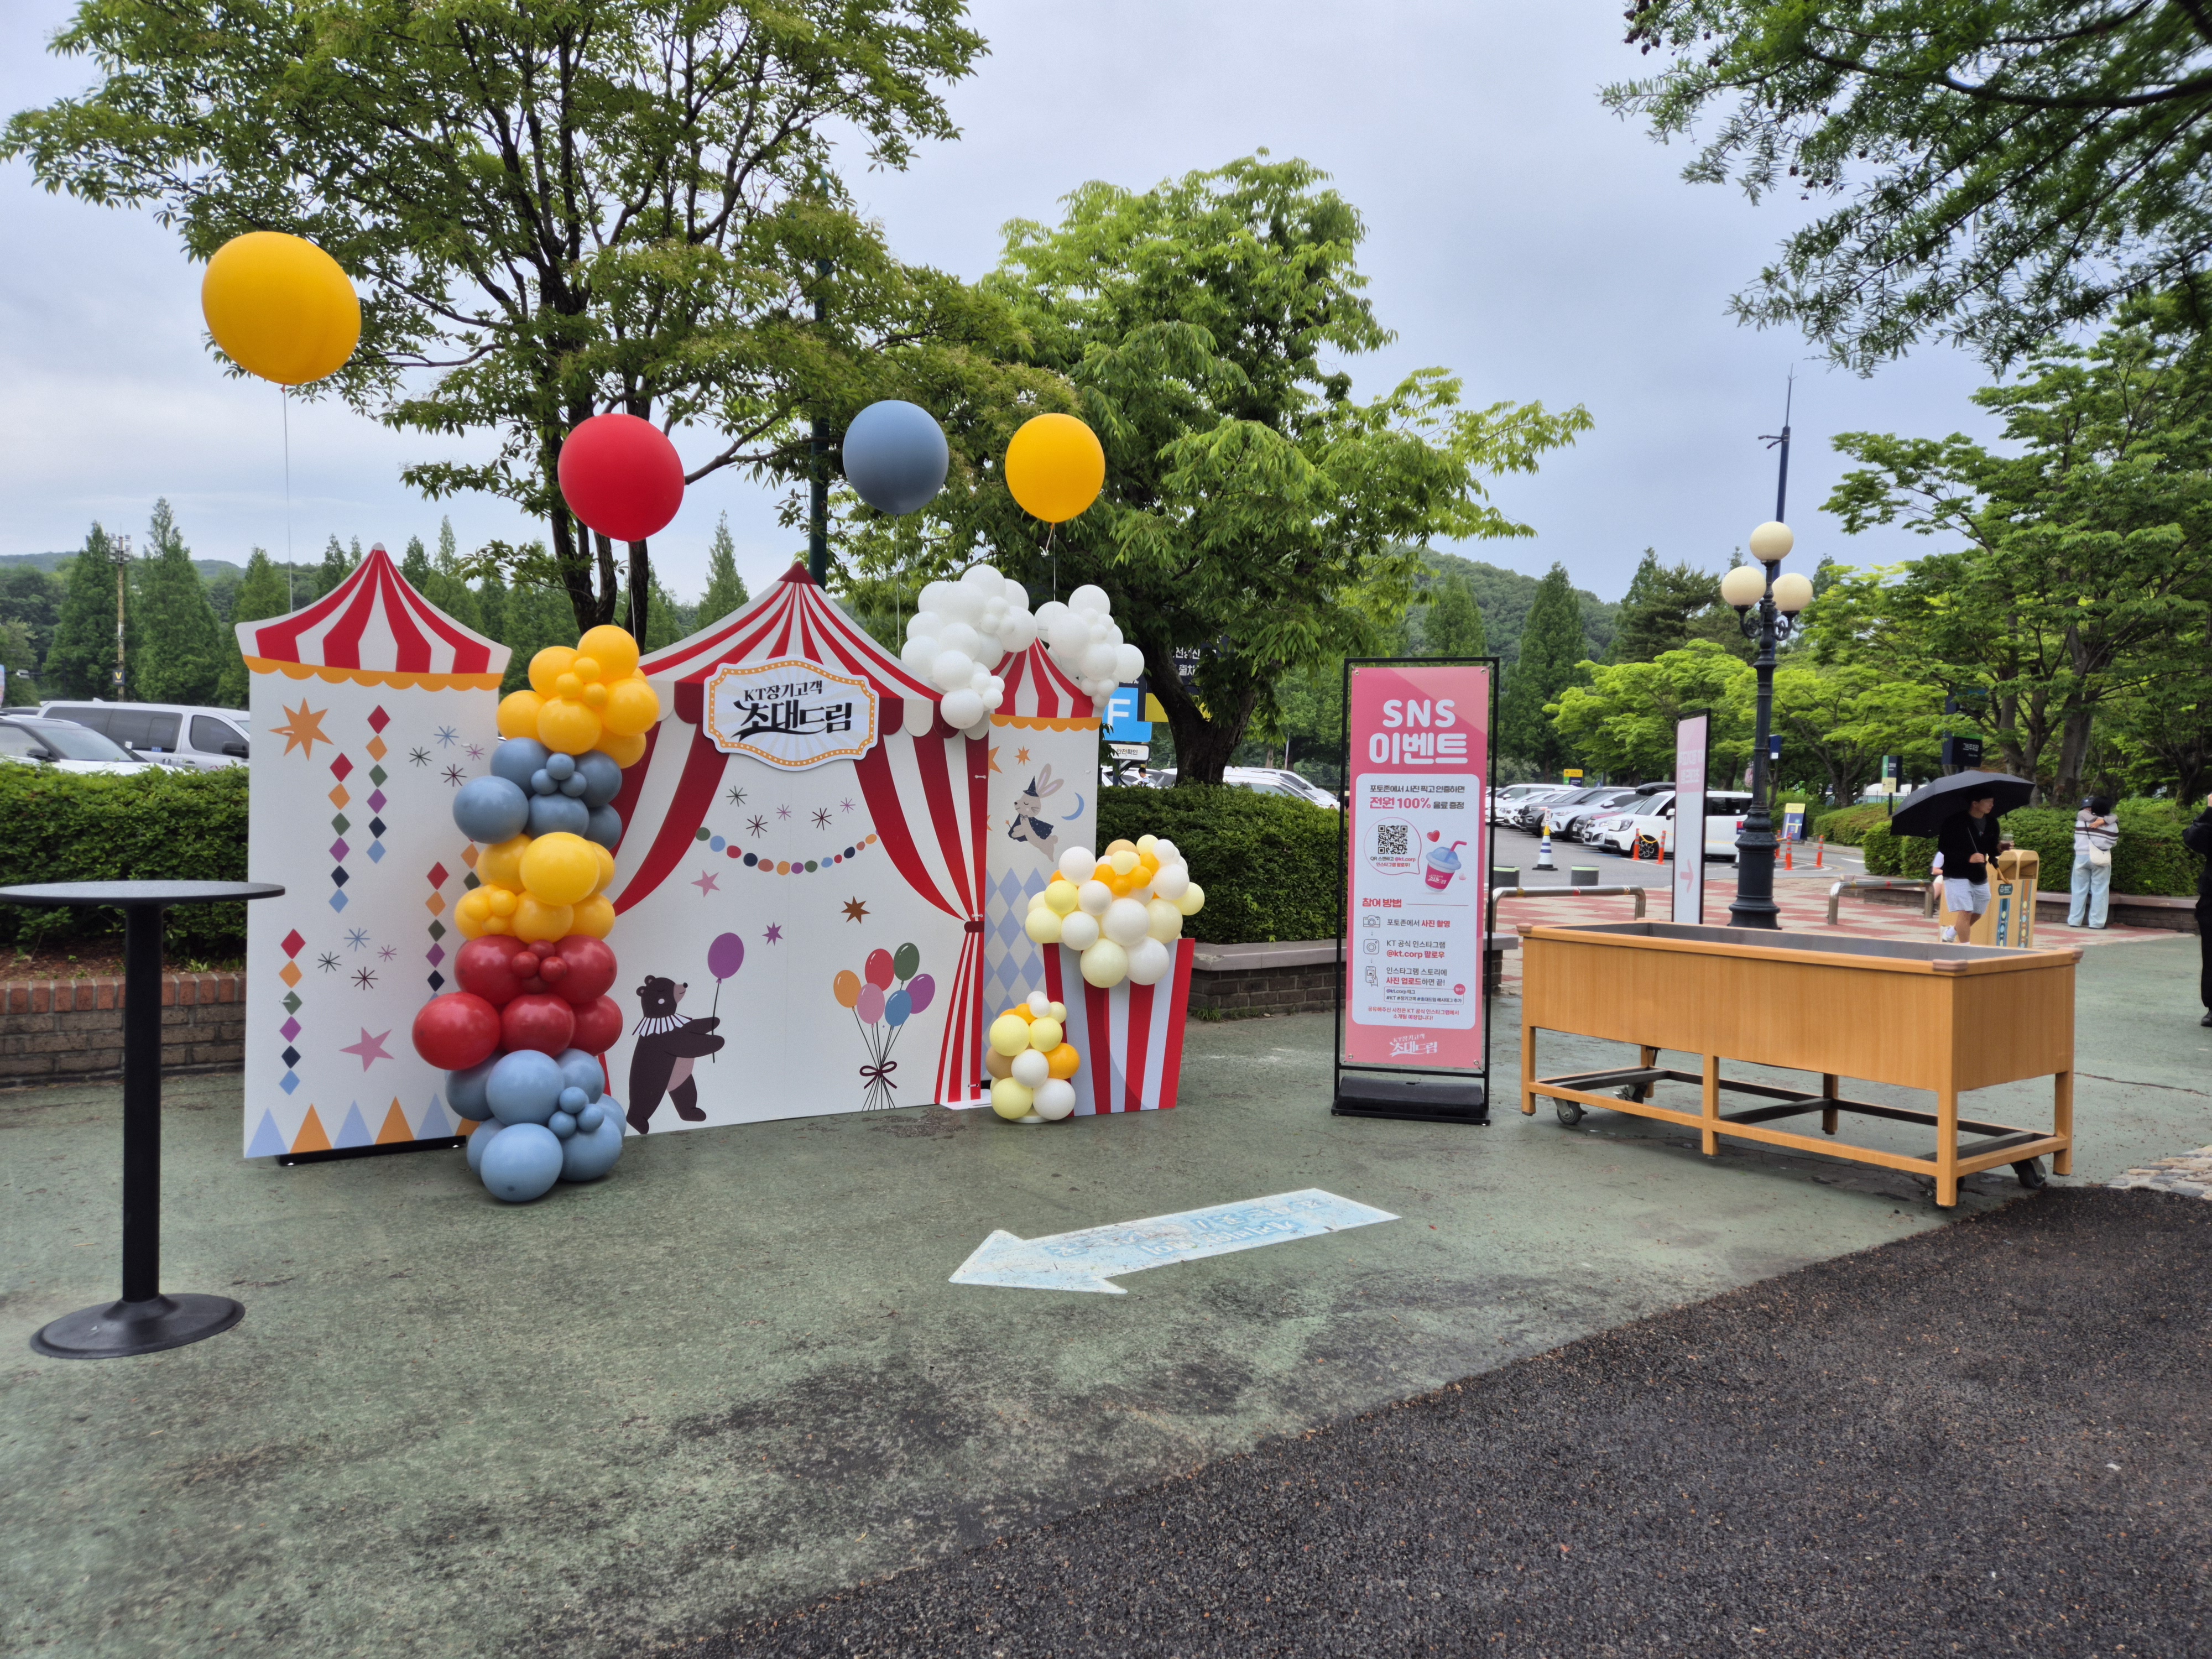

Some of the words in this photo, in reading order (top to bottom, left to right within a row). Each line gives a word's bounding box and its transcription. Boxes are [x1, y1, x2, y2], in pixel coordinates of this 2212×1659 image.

[744, 680, 822, 702] KT장기고객
[730, 699, 852, 743] 초대드림
[1108, 698, 1131, 729] F
[1383, 699, 1455, 728] SNS
[1369, 732, 1468, 764] 이벤트
[1370, 797, 1395, 809] 전원
[1397, 797, 1431, 808] 100%
[1362, 898, 1381, 907] 참여
[1383, 898, 1402, 908] 방법
[1386, 950, 1423, 959] @kt.corp
[1386, 967, 1419, 975] 인스타그램
[1401, 977, 1434, 985] 업로드하면
[1389, 1041, 1437, 1057] 초대드림
